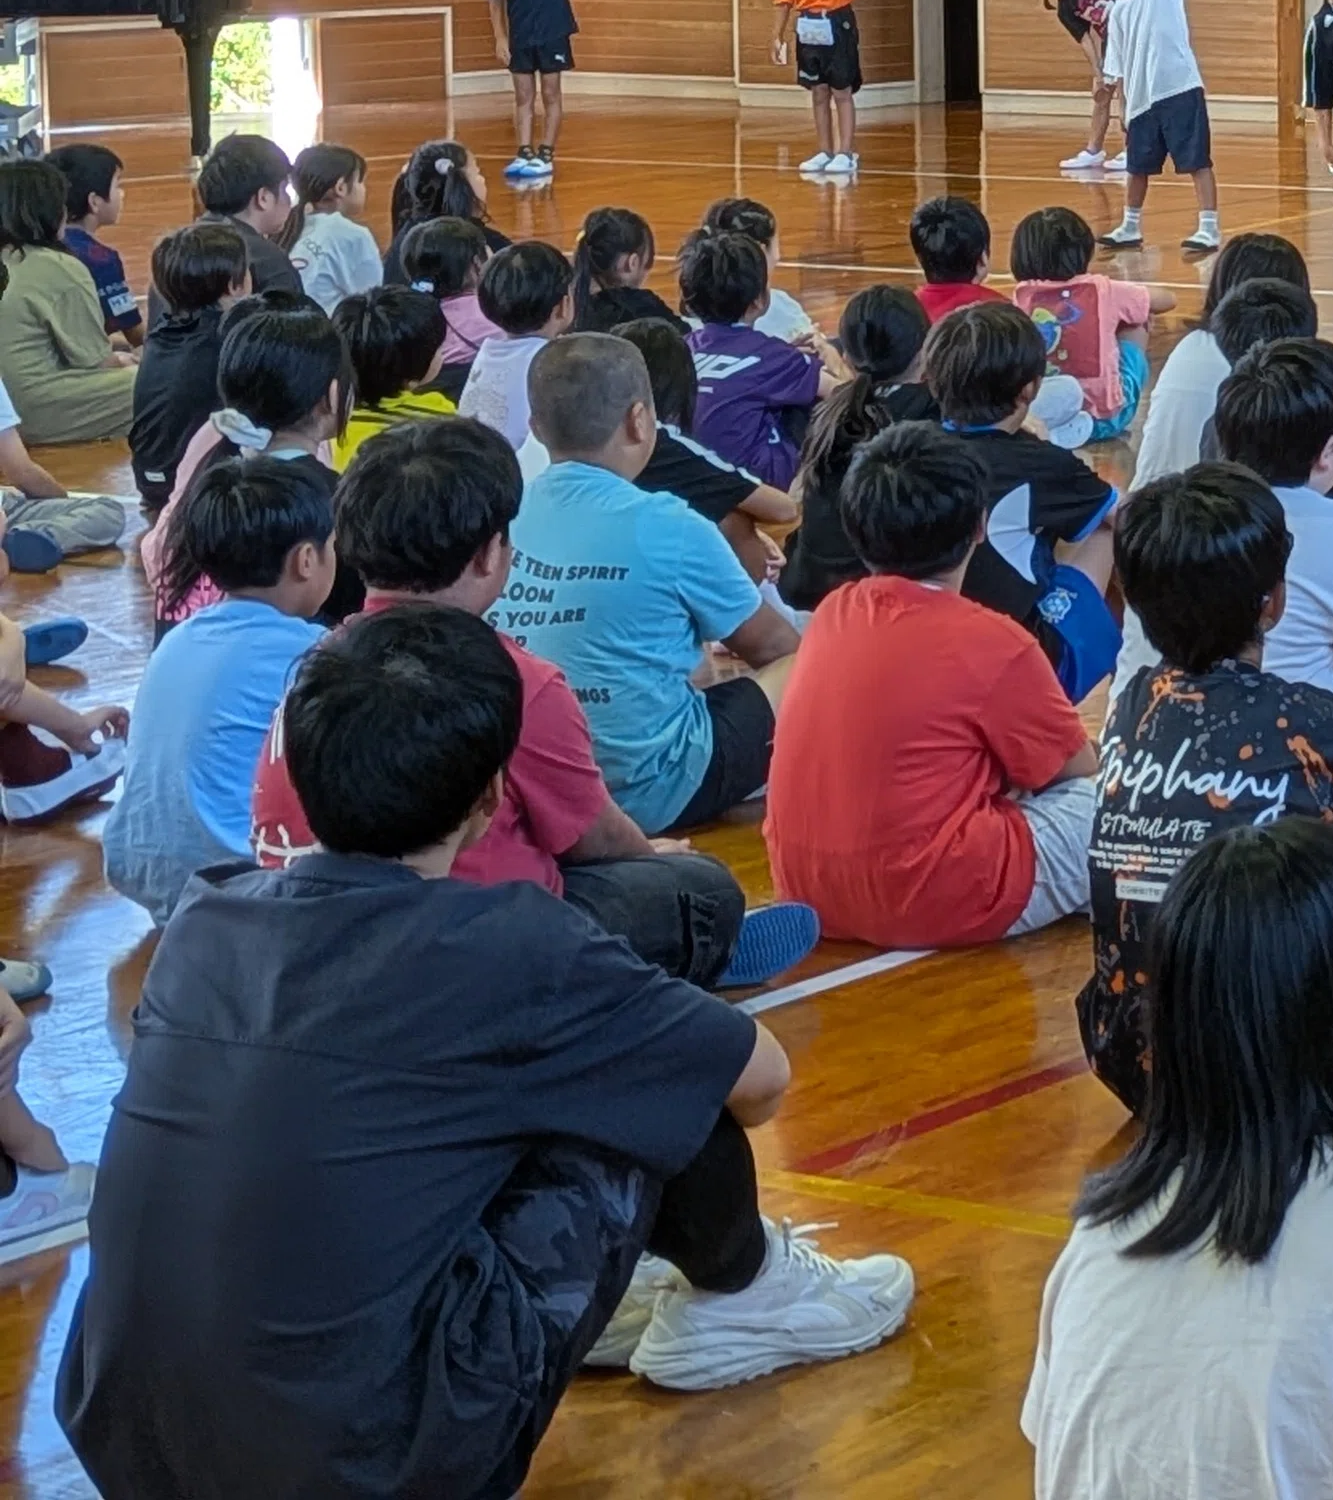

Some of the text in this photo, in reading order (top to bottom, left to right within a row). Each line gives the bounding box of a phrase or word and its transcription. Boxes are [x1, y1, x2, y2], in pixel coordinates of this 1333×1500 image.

[525, 556, 564, 581] TEEN
[566, 565, 630, 581] SPIRIT
[506, 611, 547, 628] YOU
[549, 608, 587, 625] ARE
[1100, 812, 1212, 842] STIMULATE
